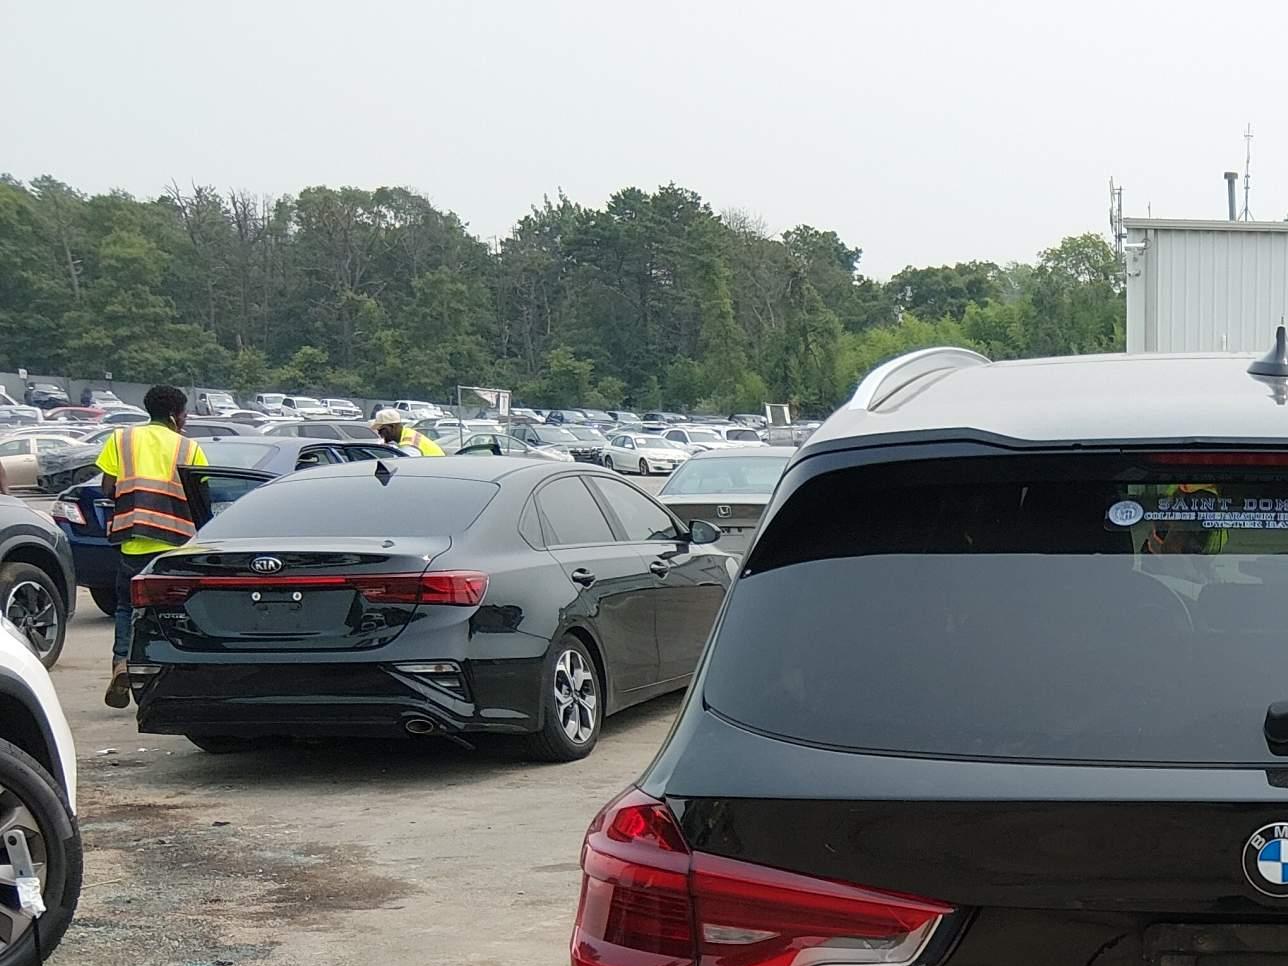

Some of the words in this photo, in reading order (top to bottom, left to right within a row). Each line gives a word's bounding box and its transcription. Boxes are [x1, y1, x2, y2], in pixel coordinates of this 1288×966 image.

[1158, 497, 1232, 511] SAINT
[1144, 512, 1196, 520] COLLEGE
[1197, 512, 1276, 521] PREPARATORY
[1202, 520, 1263, 528] OYSTER
[255, 560, 276, 570] KIA
